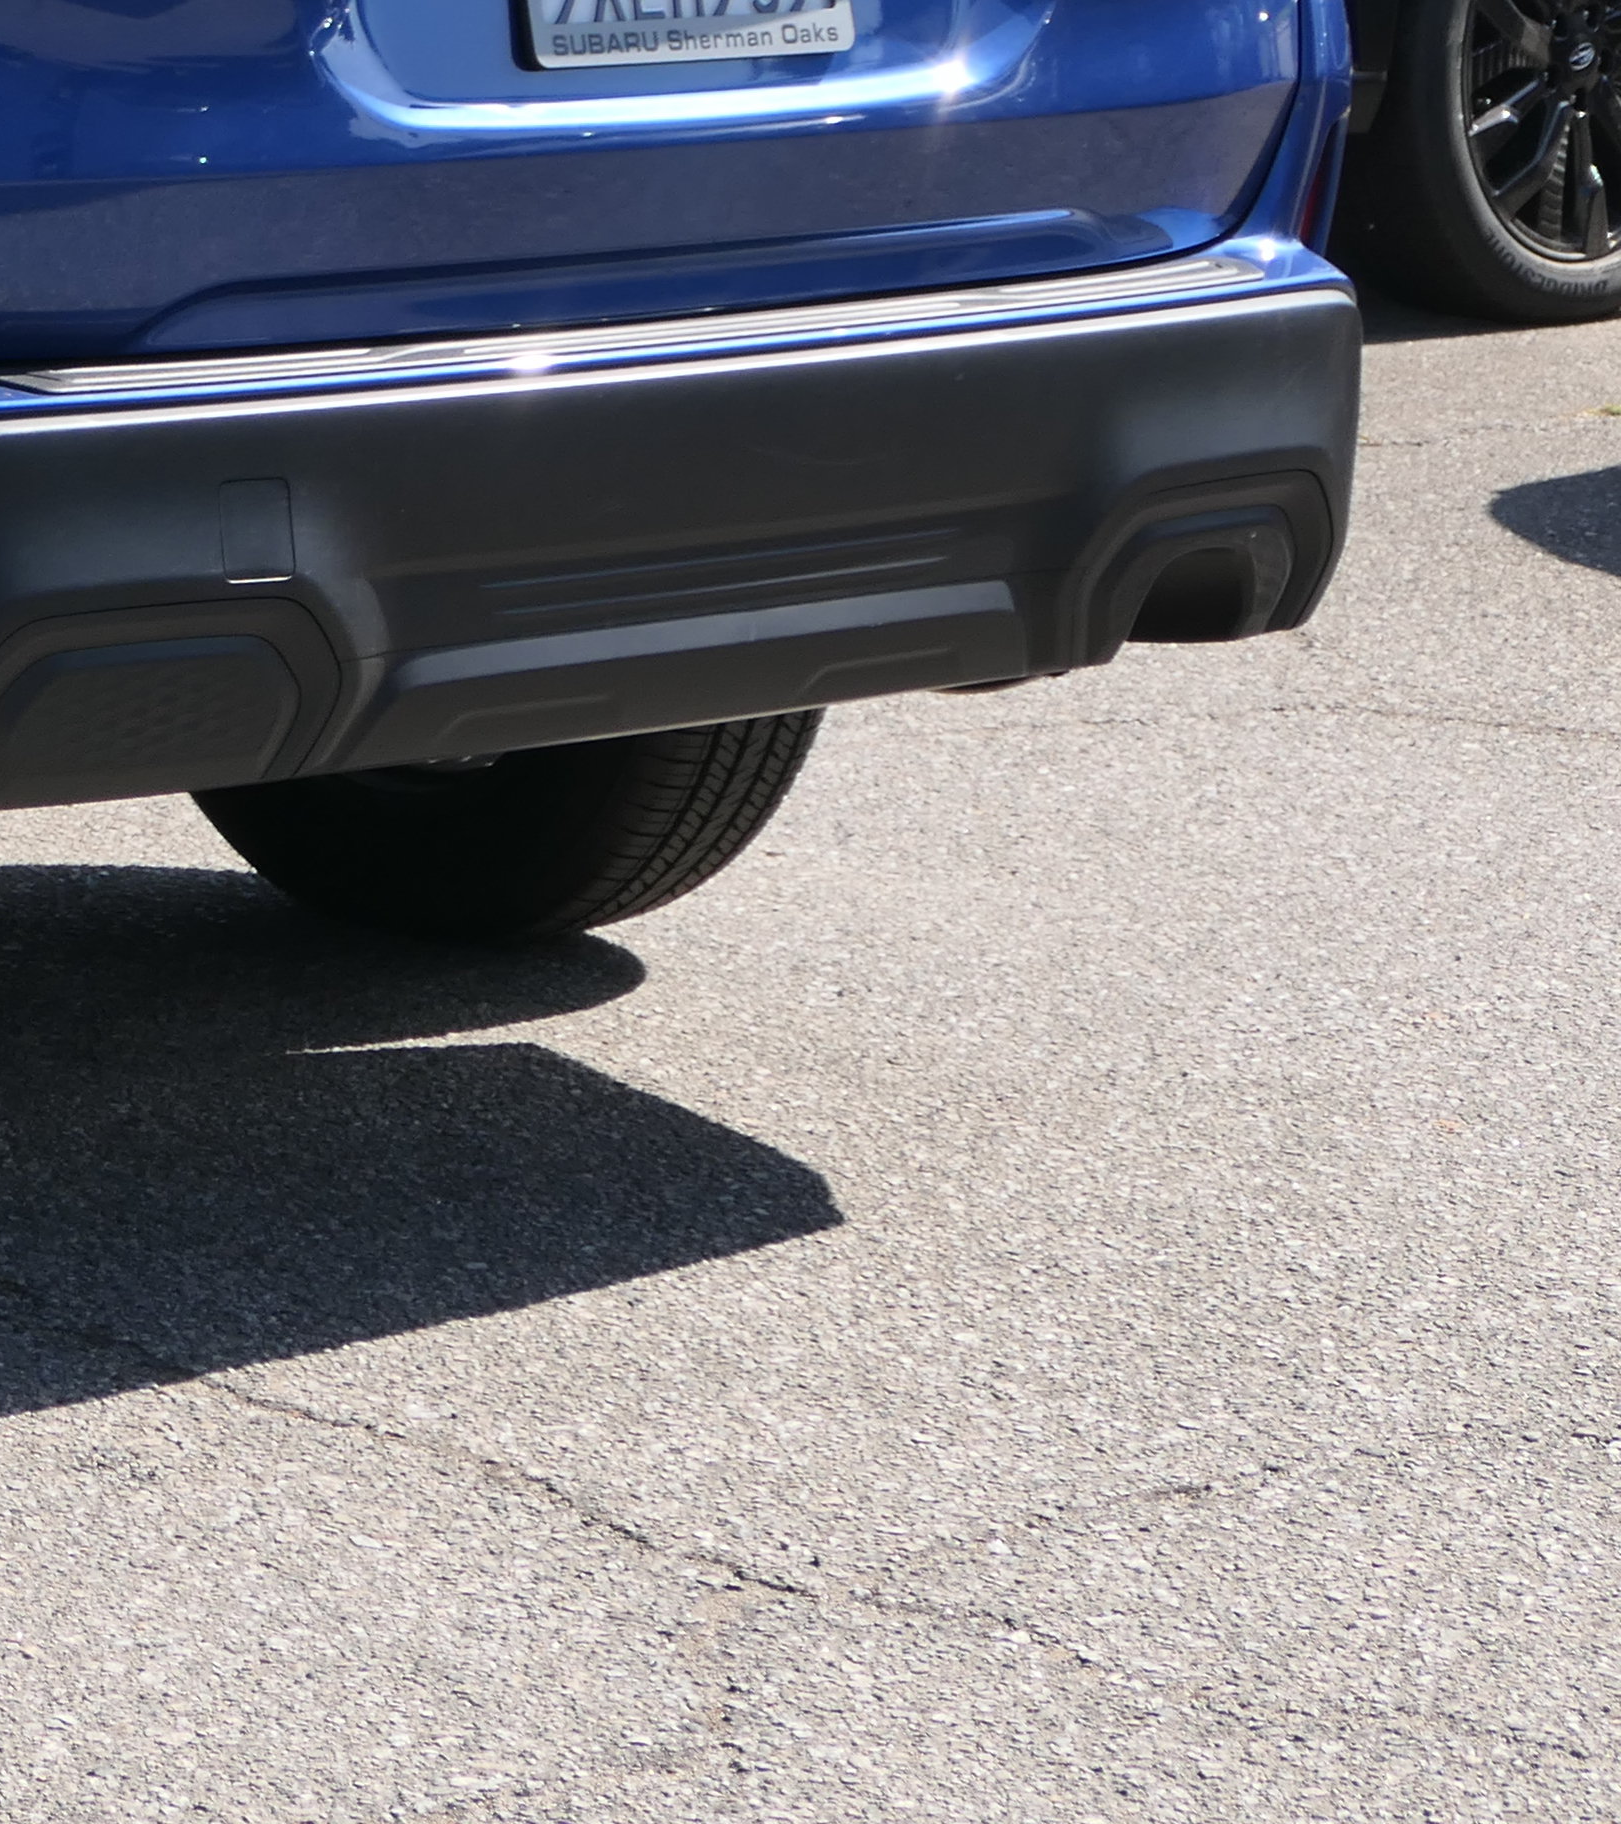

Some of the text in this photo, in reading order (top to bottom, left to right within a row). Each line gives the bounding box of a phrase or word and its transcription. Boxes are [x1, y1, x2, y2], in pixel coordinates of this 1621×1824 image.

[552, 22, 840, 57] SUBARU Sherman Oaks
